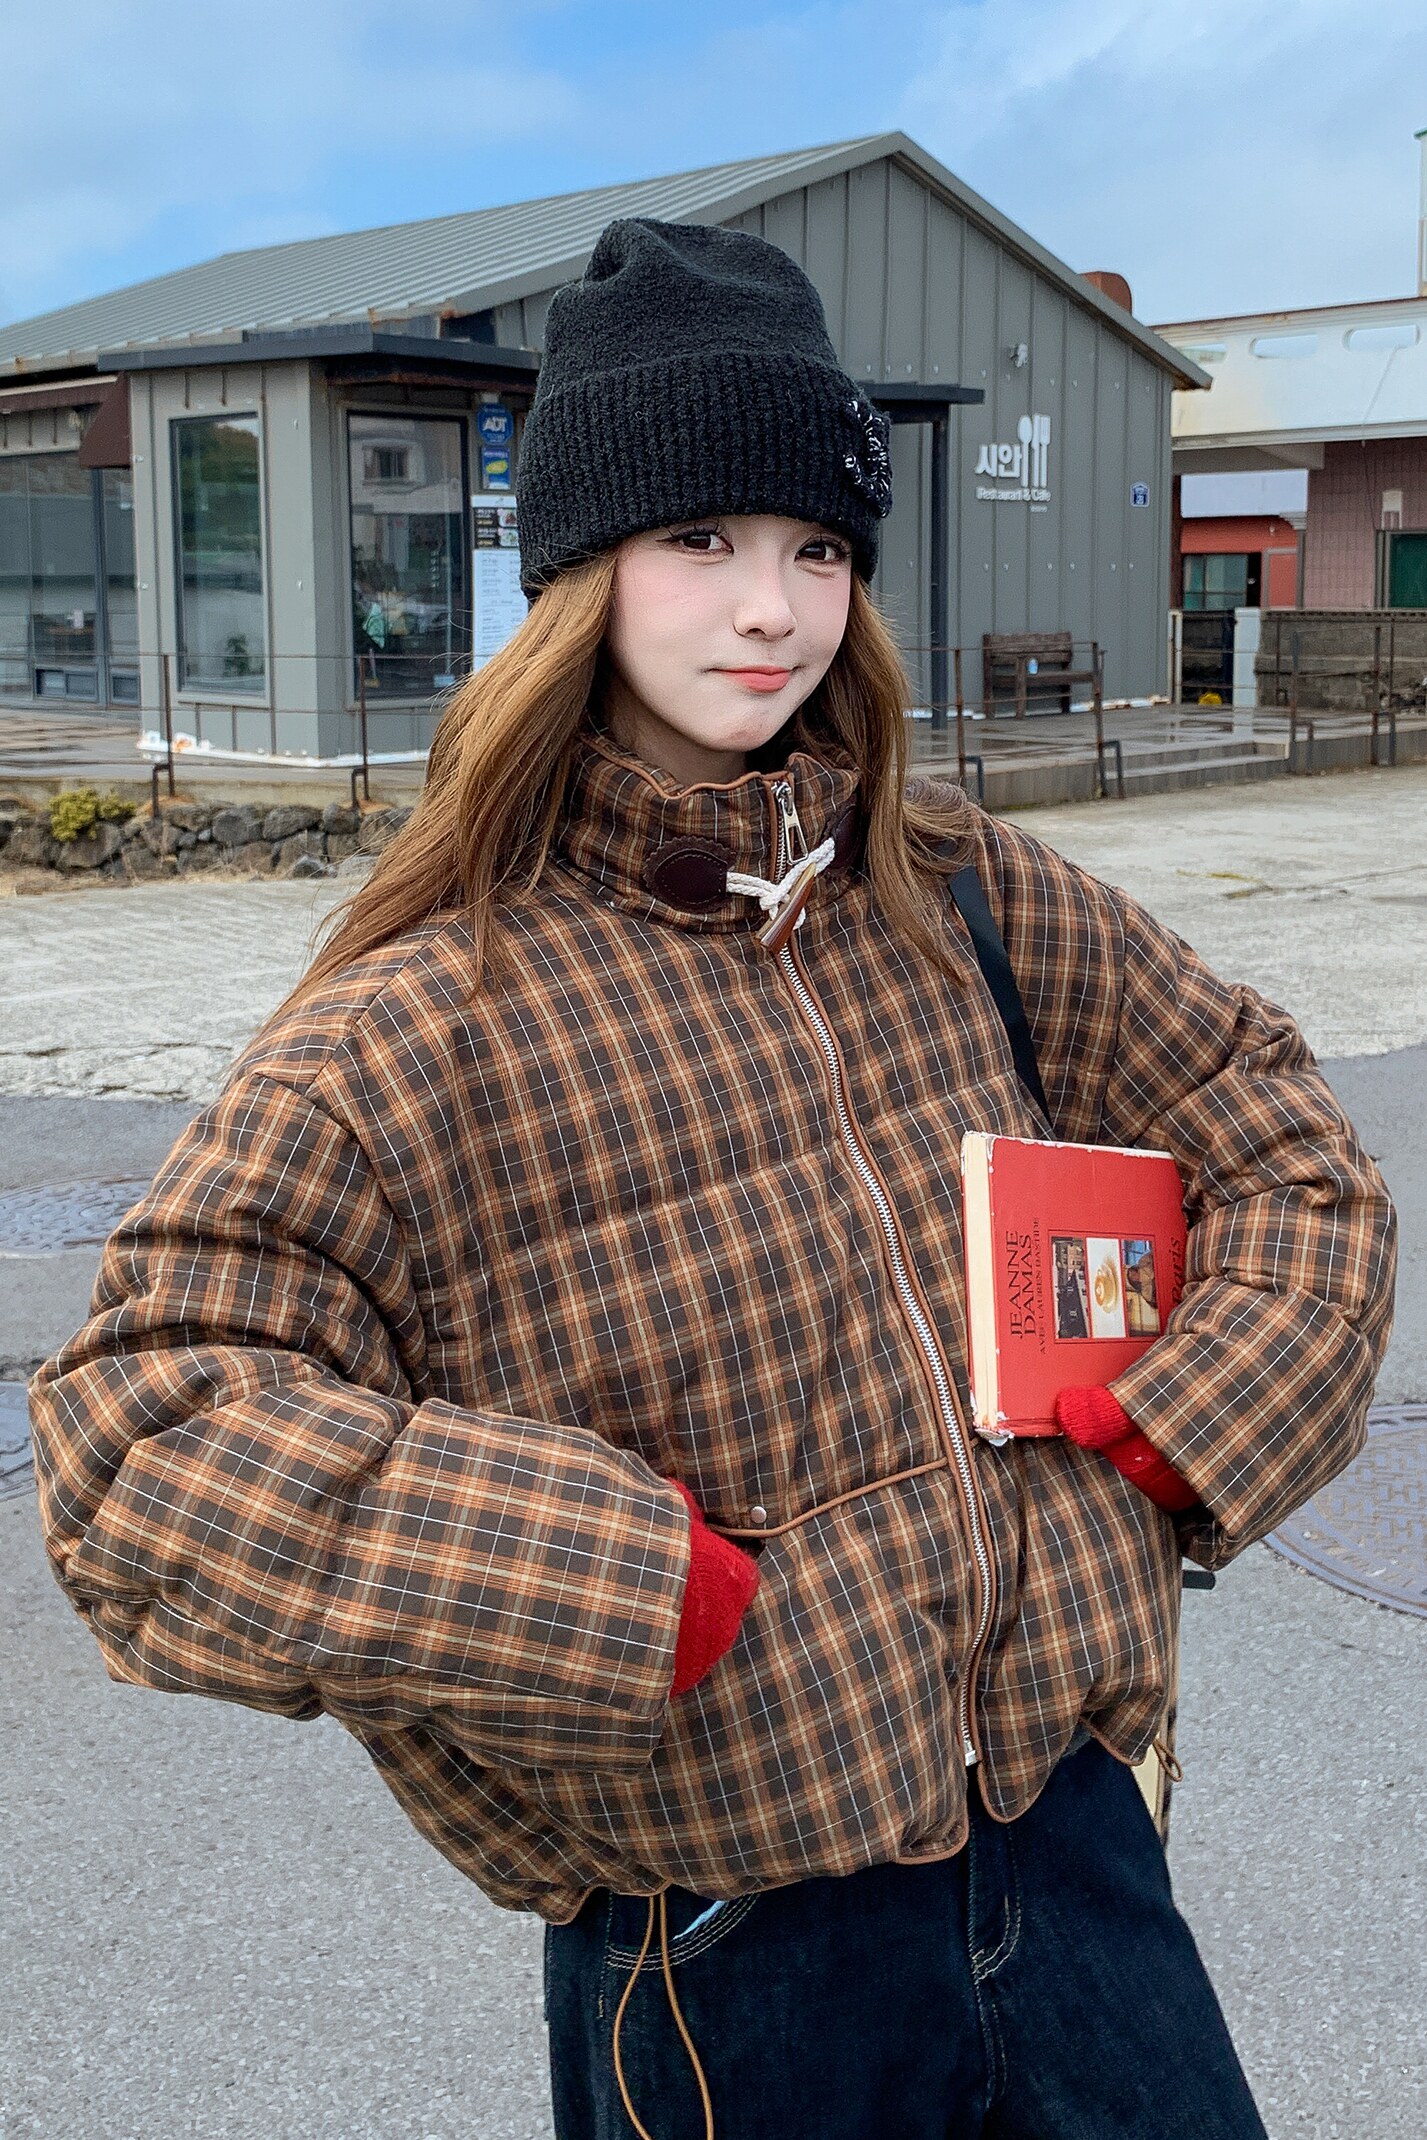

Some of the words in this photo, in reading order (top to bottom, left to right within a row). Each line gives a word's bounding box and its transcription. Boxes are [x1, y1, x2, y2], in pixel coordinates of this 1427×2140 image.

[482, 416, 508, 433] ADT
[974, 443, 1023, 477] 시안
[1023, 488, 1031, 502] &
[1006, 1230, 1023, 1340] JEANNE
[1019, 1234, 1036, 1336] DAMAS
[1035, 1270, 1045, 1319] LAUREN
[1169, 1237, 1184, 1304] Paris
